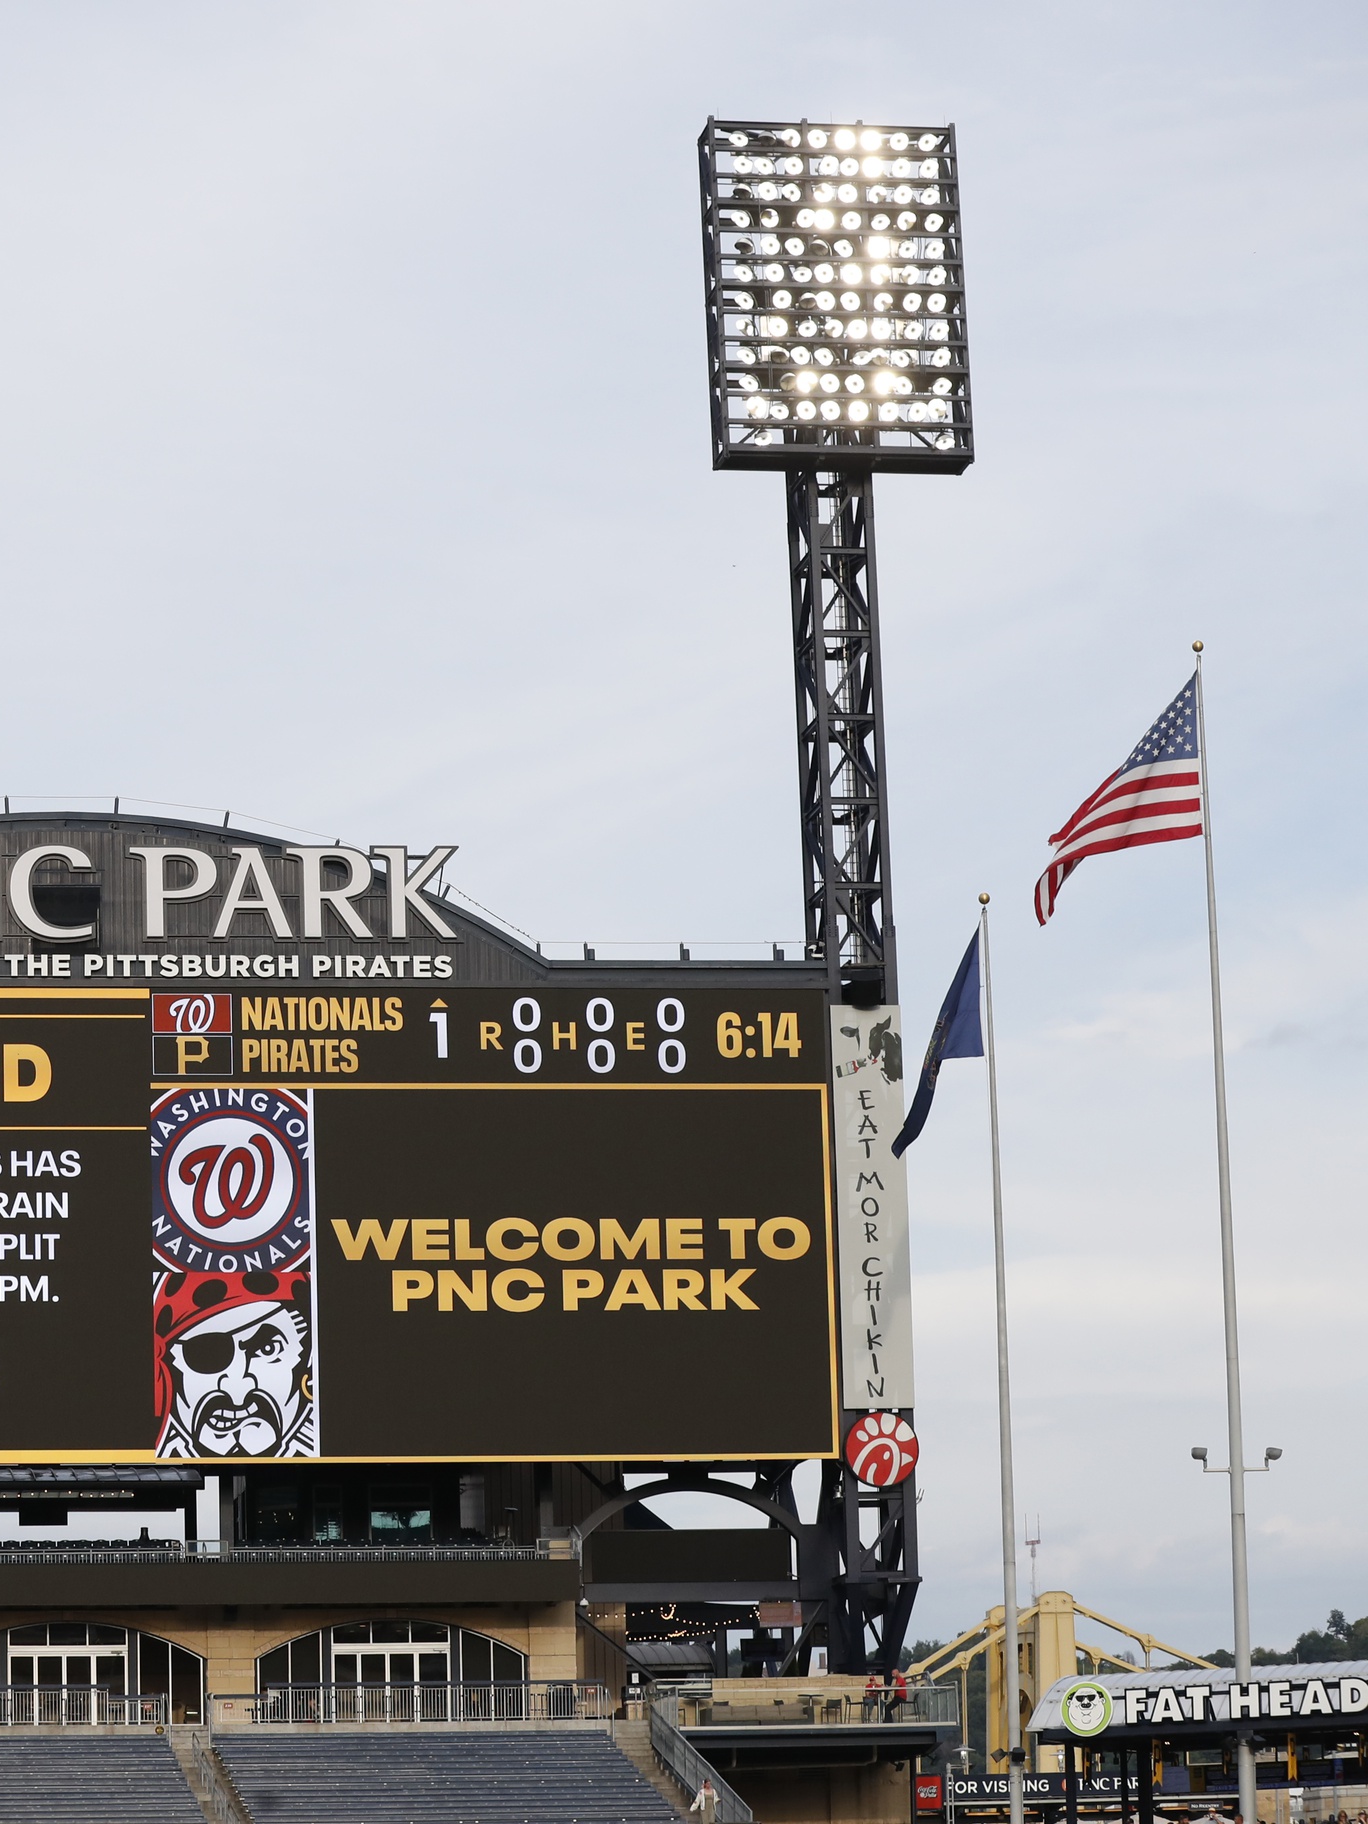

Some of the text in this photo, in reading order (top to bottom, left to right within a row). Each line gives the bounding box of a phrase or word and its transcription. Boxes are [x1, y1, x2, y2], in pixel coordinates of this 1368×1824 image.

[130, 843, 458, 941] PARK
[4, 954, 71, 977] THE
[84, 954, 299, 978] PITTSBURGH
[312, 955, 453, 978] PIRATES
[241, 996, 404, 1032] NATIONALS
[512, 997, 541, 1032] 0
[586, 997, 615, 1033] 0
[656, 997, 685, 1033] 0
[428, 1012, 448, 1059] 1
[480, 1021, 504, 1051] R
[552, 1021, 577, 1051] H
[625, 1021, 646, 1051] E
[716, 1011, 802, 1059] 6:14
[176, 1036, 210, 1074] P
[241, 1038, 359, 1074] PIRATES
[513, 1038, 542, 1074] 0
[587, 1038, 616, 1074] 0
[657, 1038, 686, 1074] 0
[10, 1150, 82, 1178] HAS
[179, 1133, 274, 1229] W
[152, 1214, 311, 1272] NATIONALS
[330, 1216, 811, 1262] WELCOME TO
[855, 1089, 886, 1398] EAT MOR CHIKIN
[391, 1267, 761, 1313] PNC PARK
[1126, 1686, 1211, 1724] FAT
[982, 1779, 1050, 1793] VISIING
